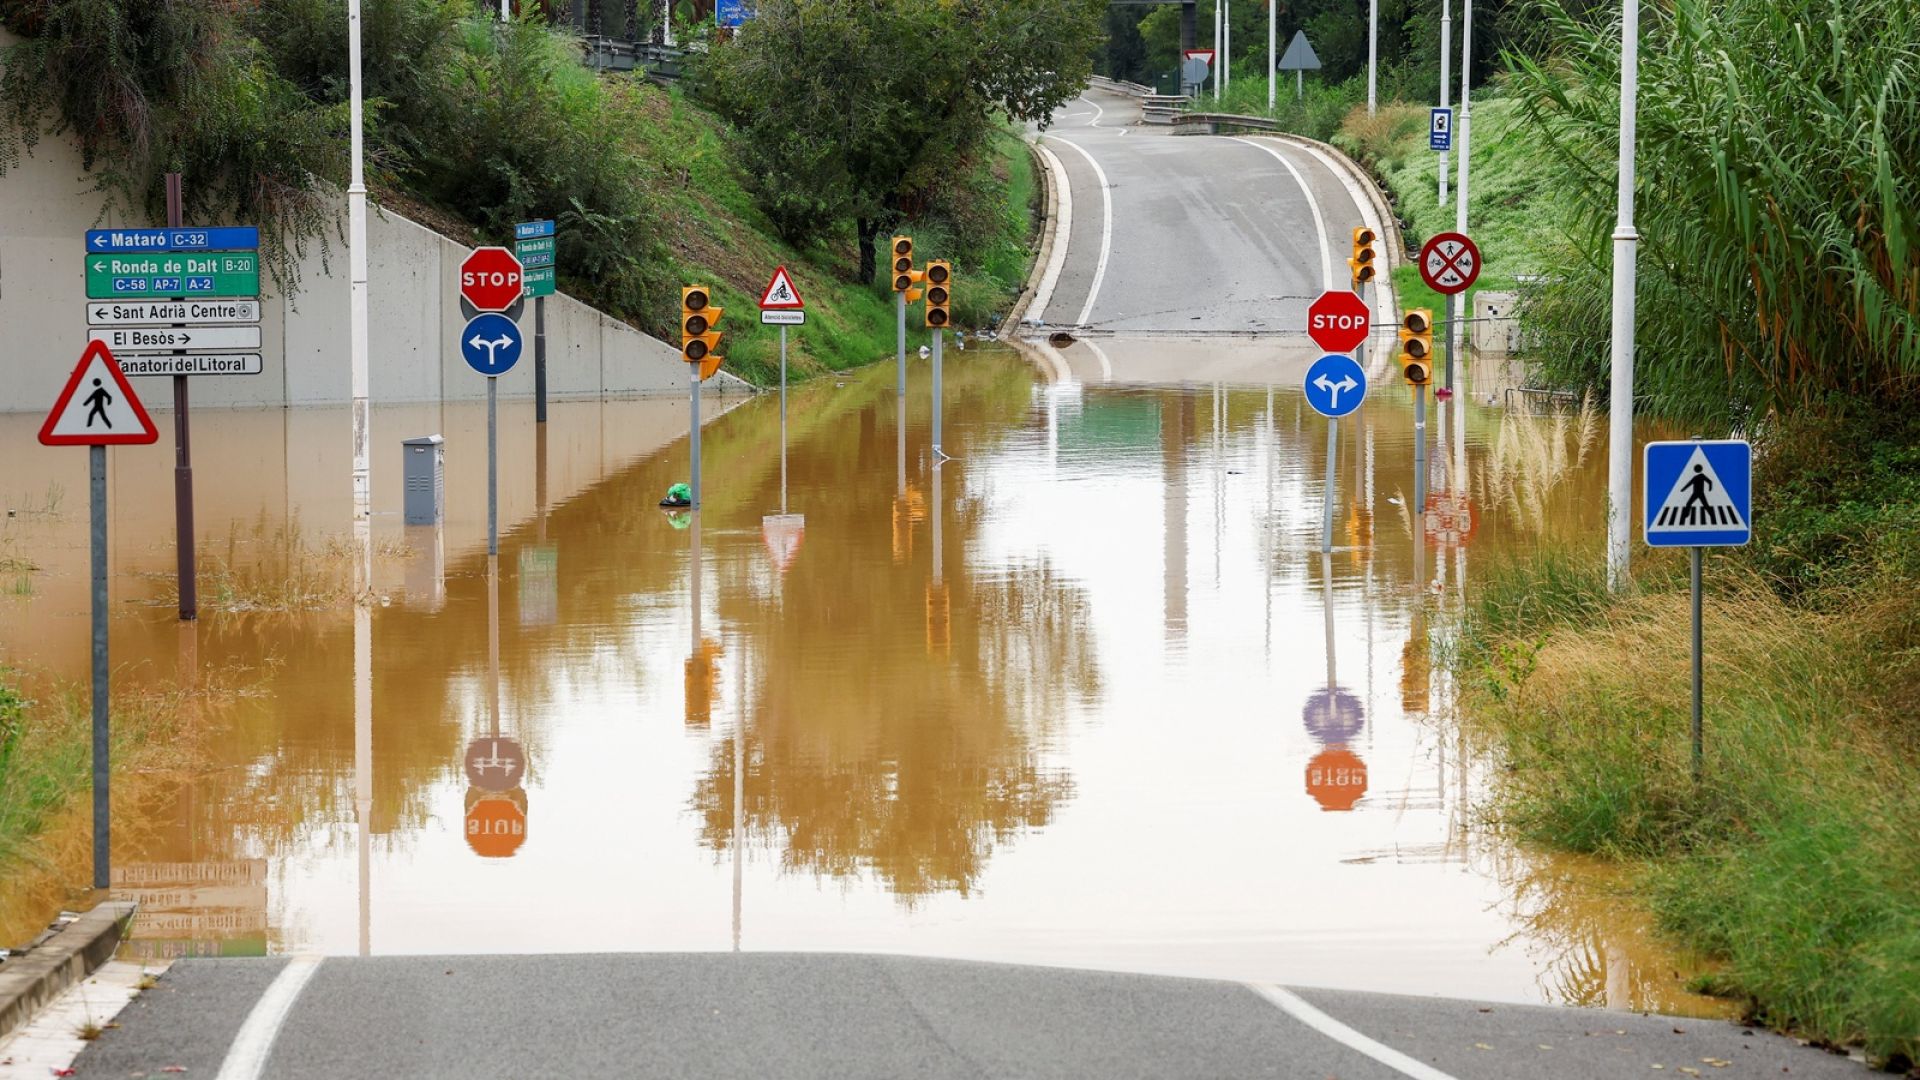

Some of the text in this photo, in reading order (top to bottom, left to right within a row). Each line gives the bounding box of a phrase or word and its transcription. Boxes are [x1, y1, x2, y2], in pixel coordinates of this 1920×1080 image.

[111, 232, 205, 246] Mataró C-32
[111, 259, 251, 274] Ronda de Dalt B-20
[115, 278, 211, 290] C-58 AP-7 A-2
[463, 272, 519, 287] STOP
[113, 304, 236, 319] Sant Adrià Centre
[1313, 314, 1365, 330] STOP
[113, 331, 175, 345] El Besòs
[175, 358, 197, 372] del
[199, 357, 246, 371] Litoral
